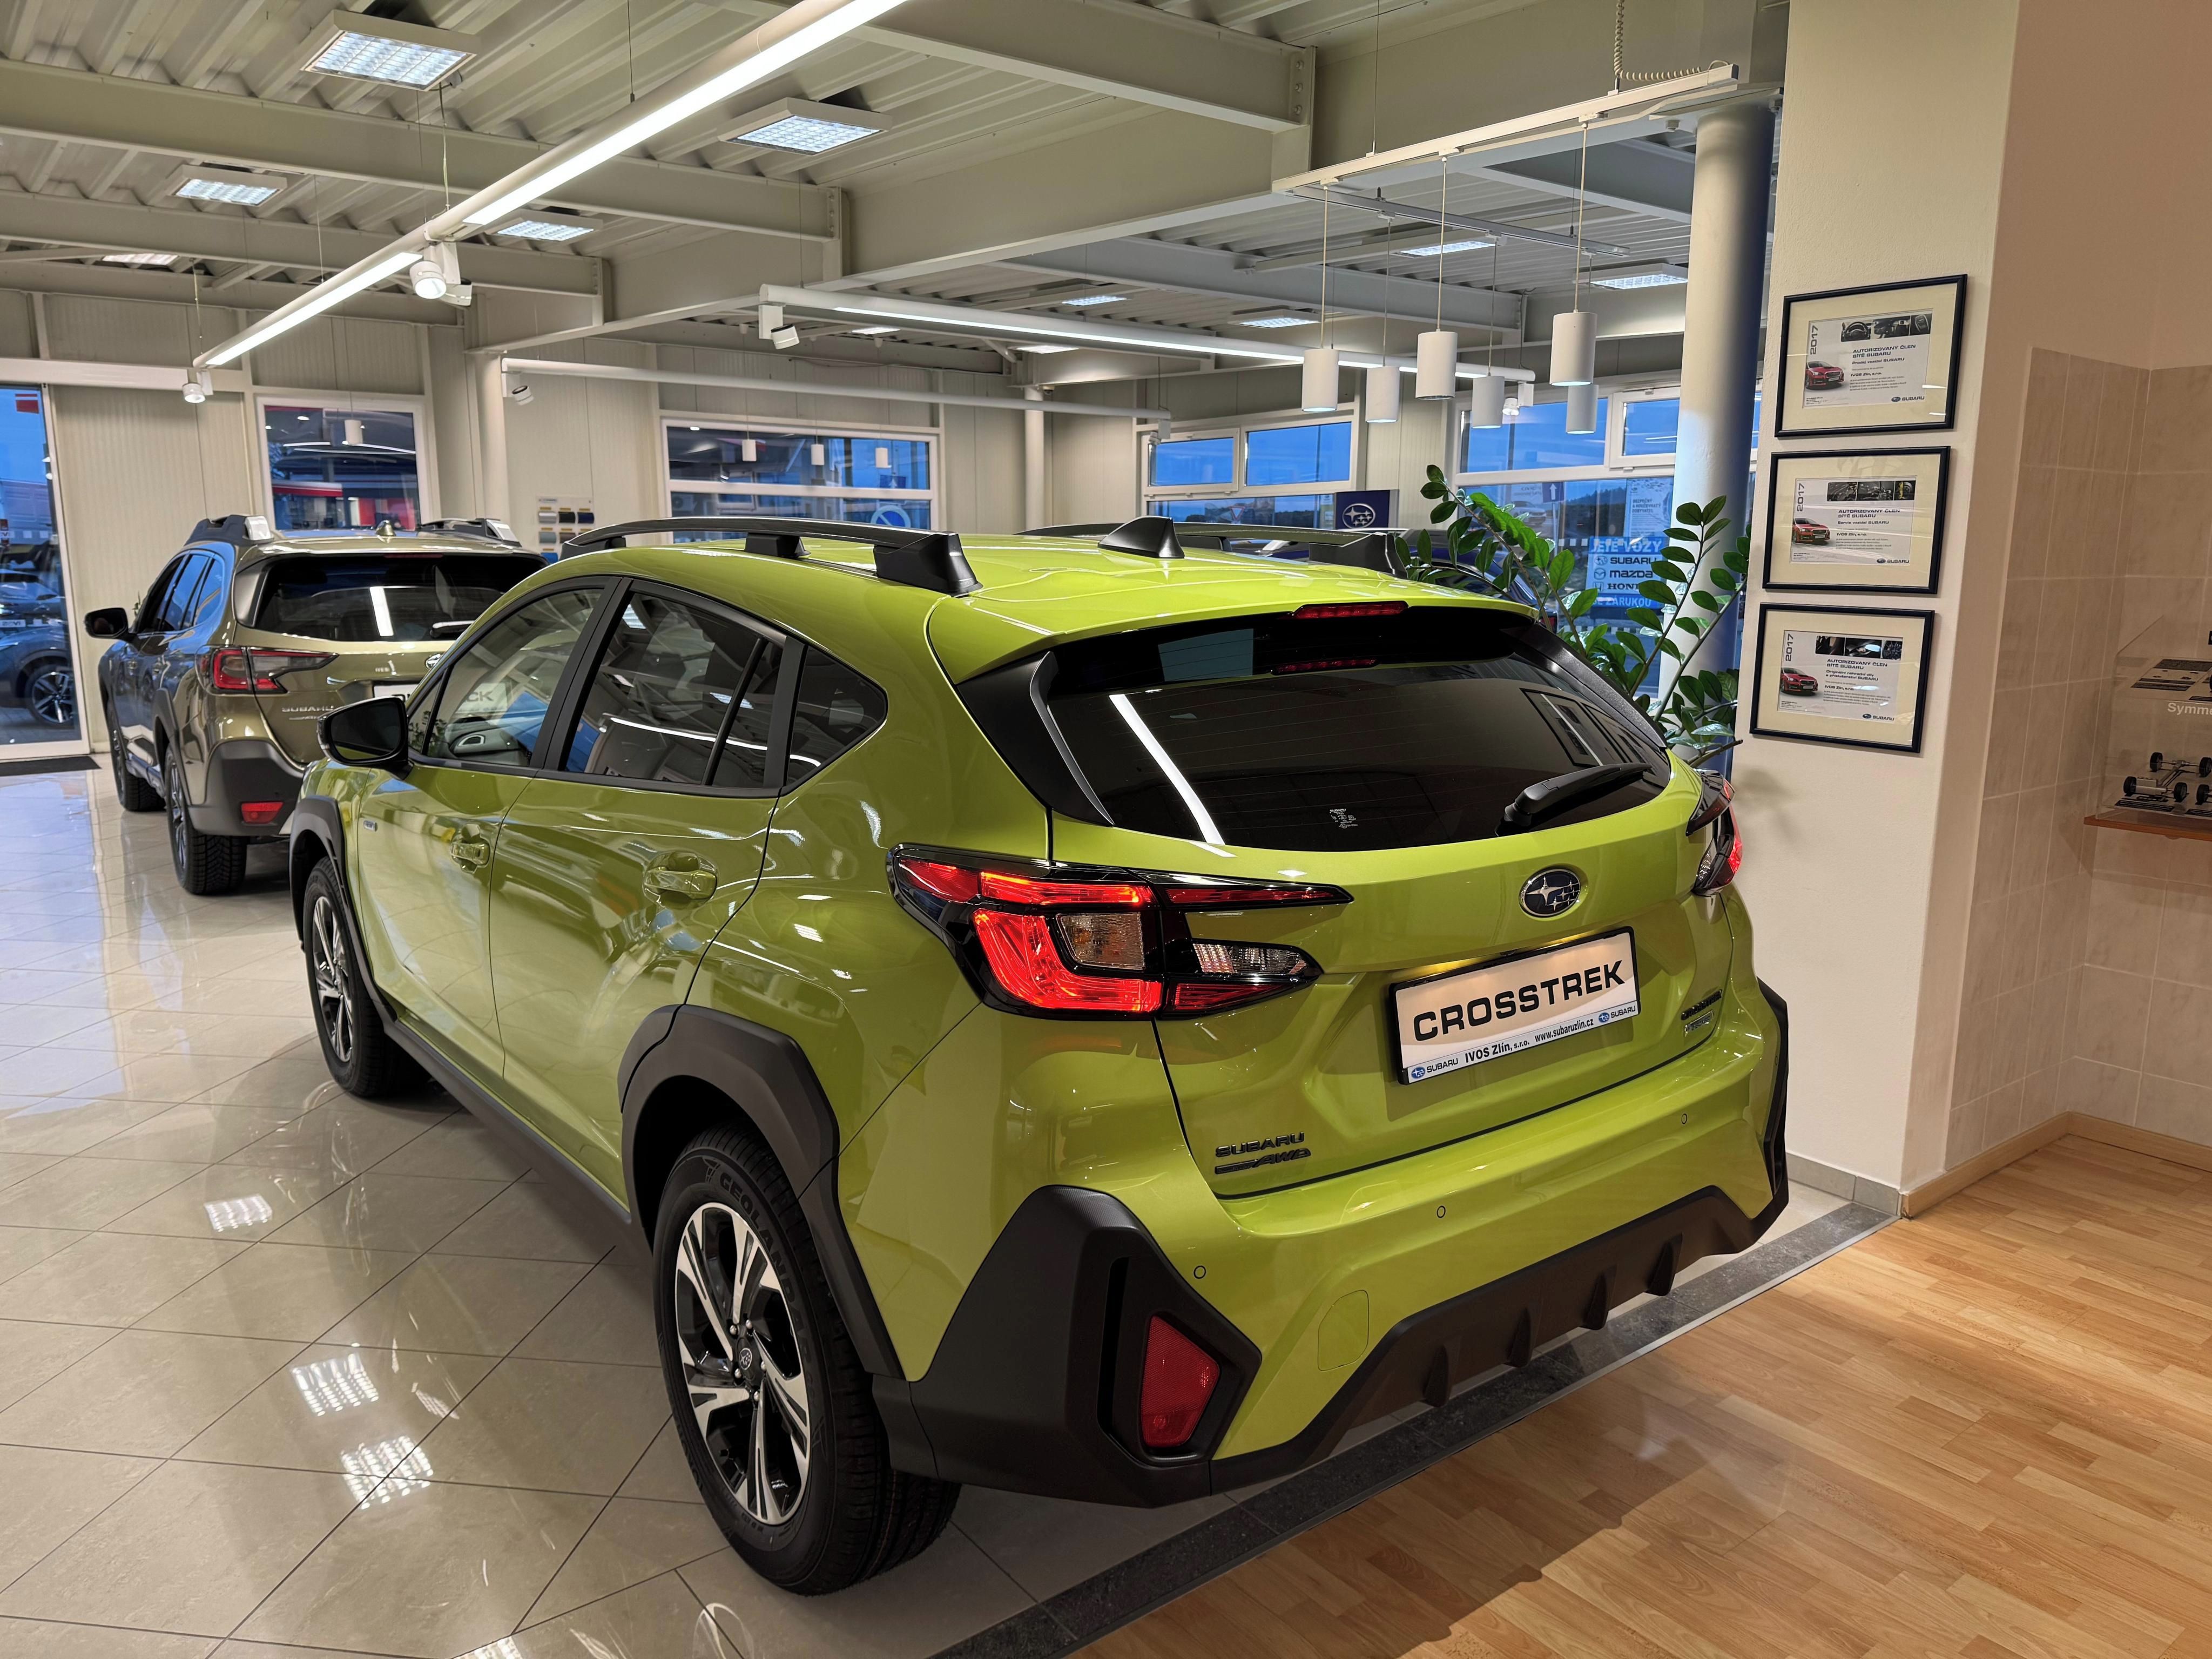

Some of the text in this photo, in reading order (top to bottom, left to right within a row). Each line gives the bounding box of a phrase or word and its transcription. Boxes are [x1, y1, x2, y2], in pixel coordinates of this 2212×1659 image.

[1810, 325, 1818, 355] 2017
[1785, 633, 1793, 662] 2017
[1413, 960, 1625, 1041] CROSSTREK
[1427, 1005, 1636, 1073] SUBARU IVOS Zlín, s.r.o. www.subaruzlin.cz SUBARU
[1215, 1131, 1305, 1157] SUBARU
[1252, 1148, 1312, 1168] AWD
[720, 1172, 812, 1363] GEOLANDAR
